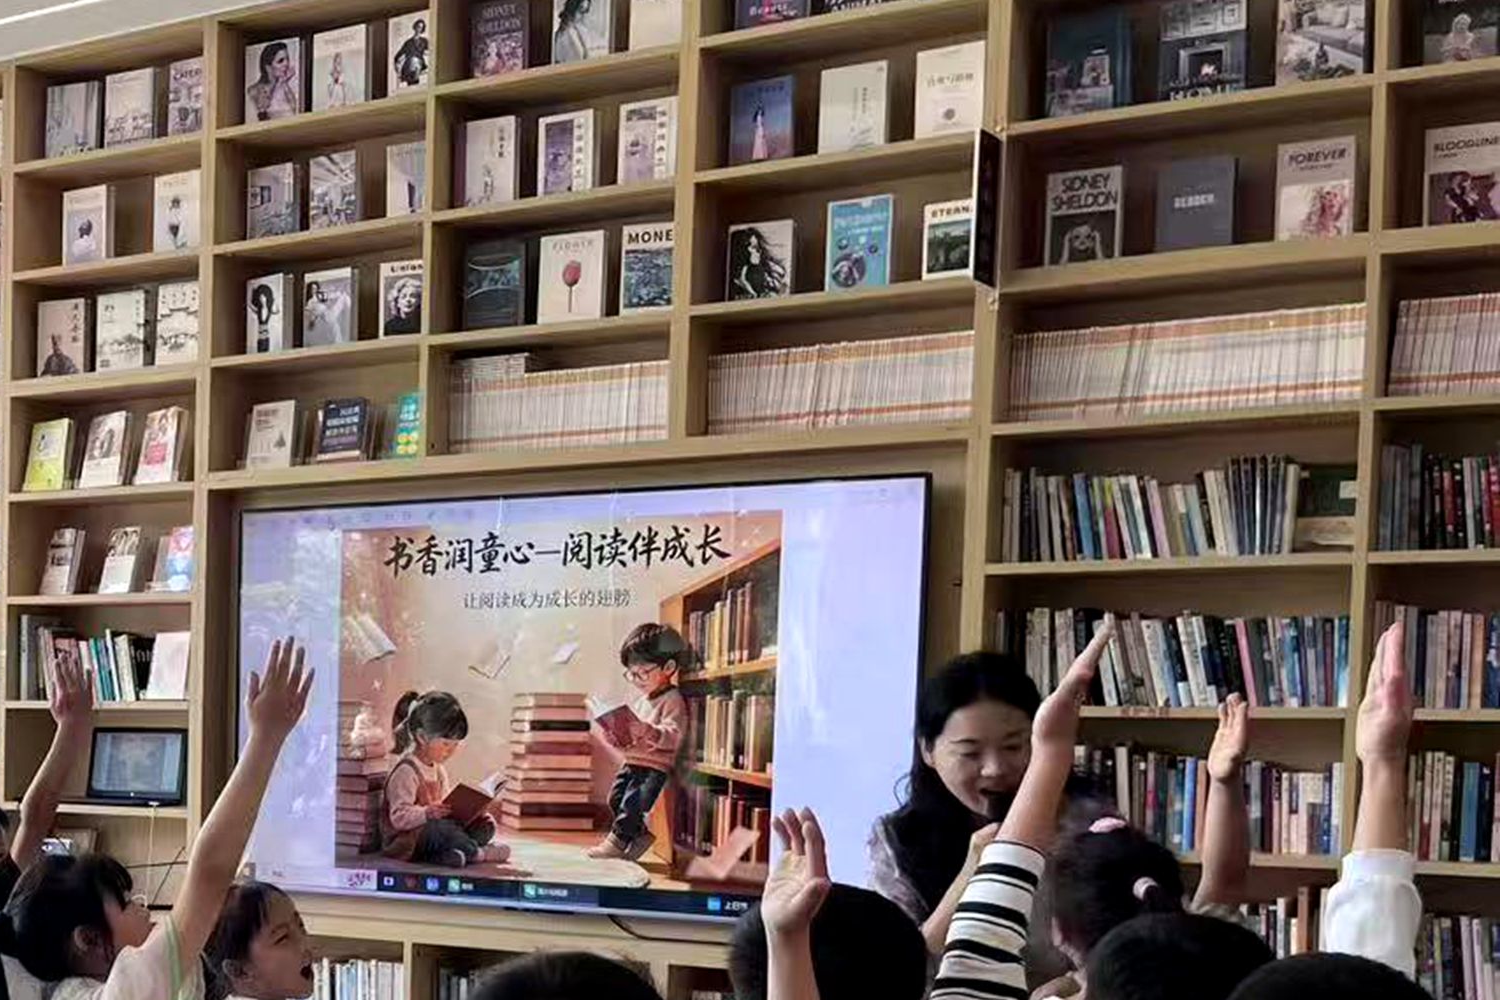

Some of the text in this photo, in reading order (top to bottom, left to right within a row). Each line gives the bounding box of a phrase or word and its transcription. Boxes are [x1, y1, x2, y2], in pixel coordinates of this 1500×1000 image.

[1287, 147, 1347, 166] FOREVER
[1061, 173, 1110, 193] SIDNEY
[1052, 190, 1119, 212] SHELDON
